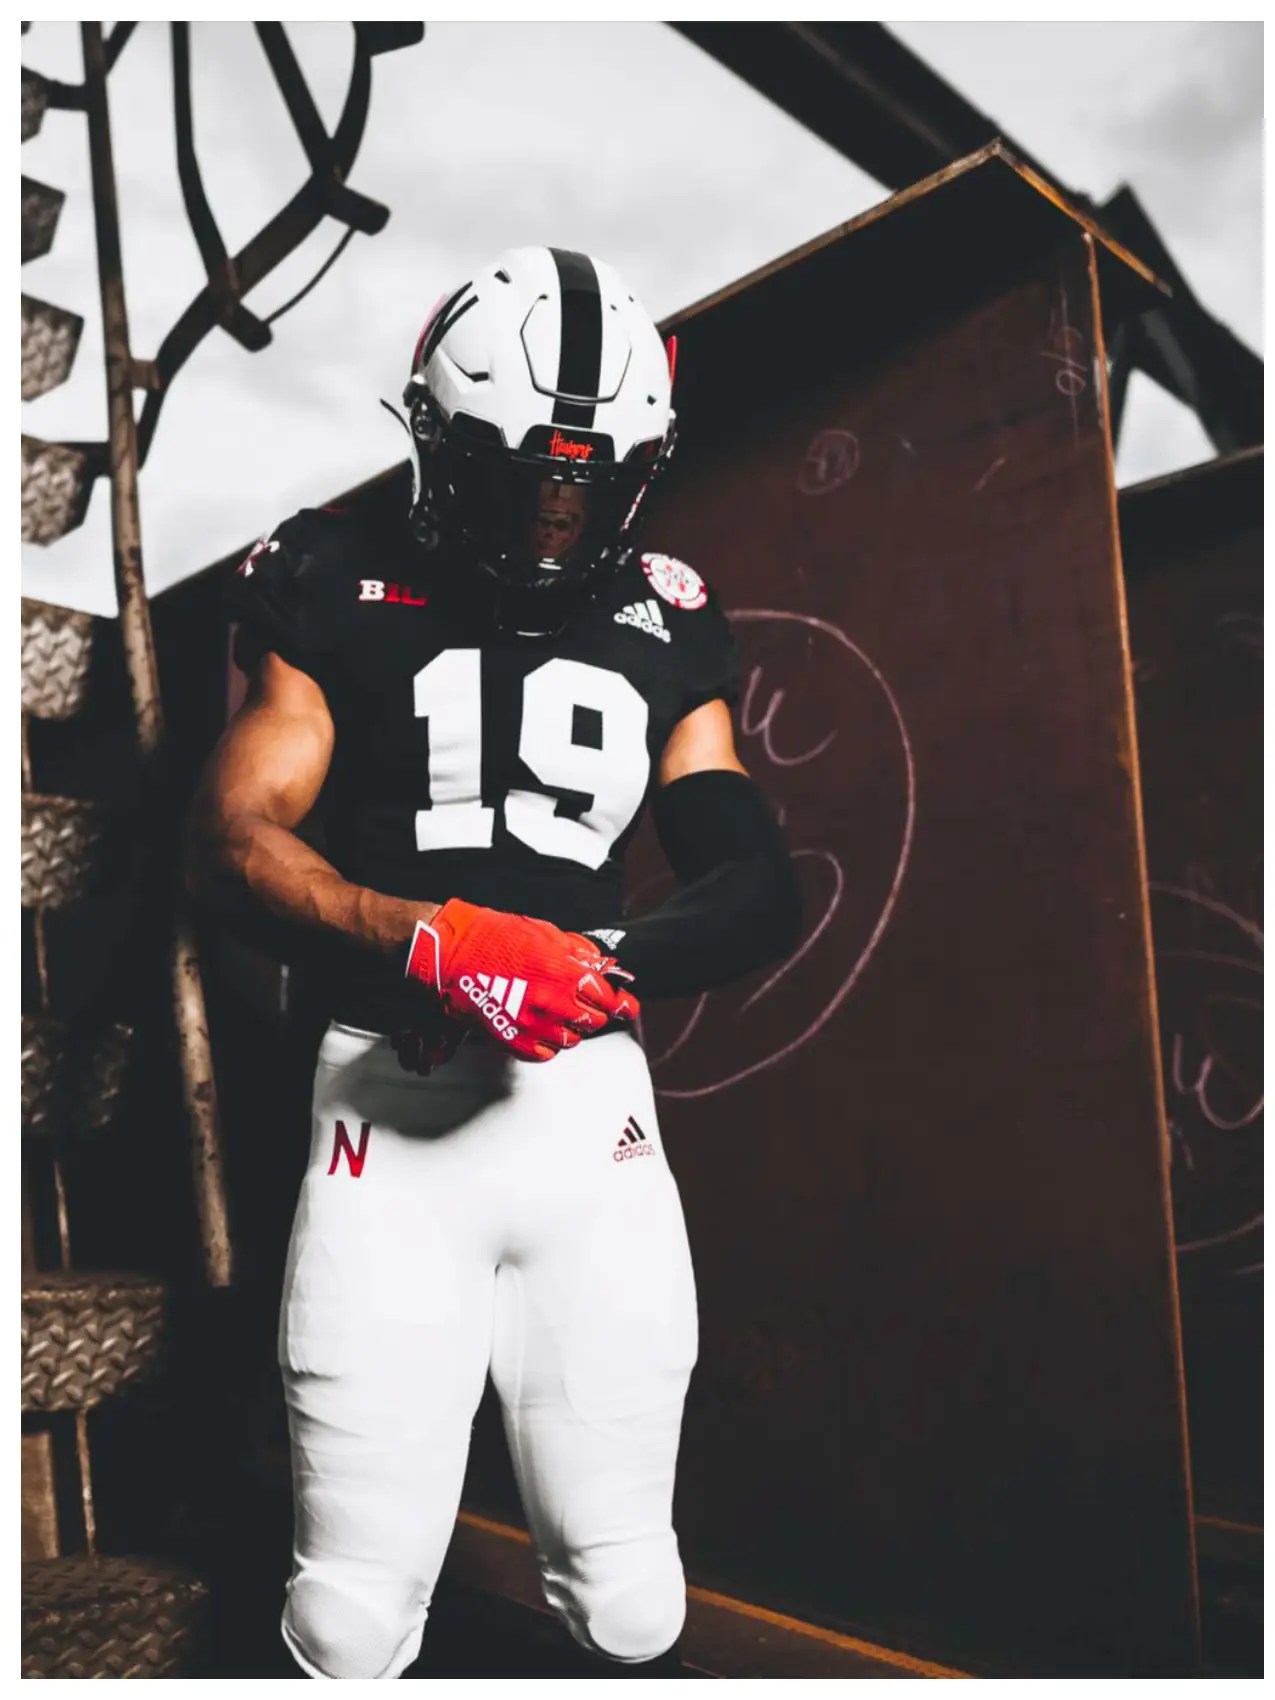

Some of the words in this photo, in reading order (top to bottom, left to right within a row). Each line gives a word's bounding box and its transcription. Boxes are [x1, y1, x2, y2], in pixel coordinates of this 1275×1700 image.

[613, 612, 671, 643] adidas
[413, 648, 651, 871] 19
[459, 975, 519, 1041] adidas
[327, 1120, 371, 1178] N
[613, 1144, 656, 1162] adidas
